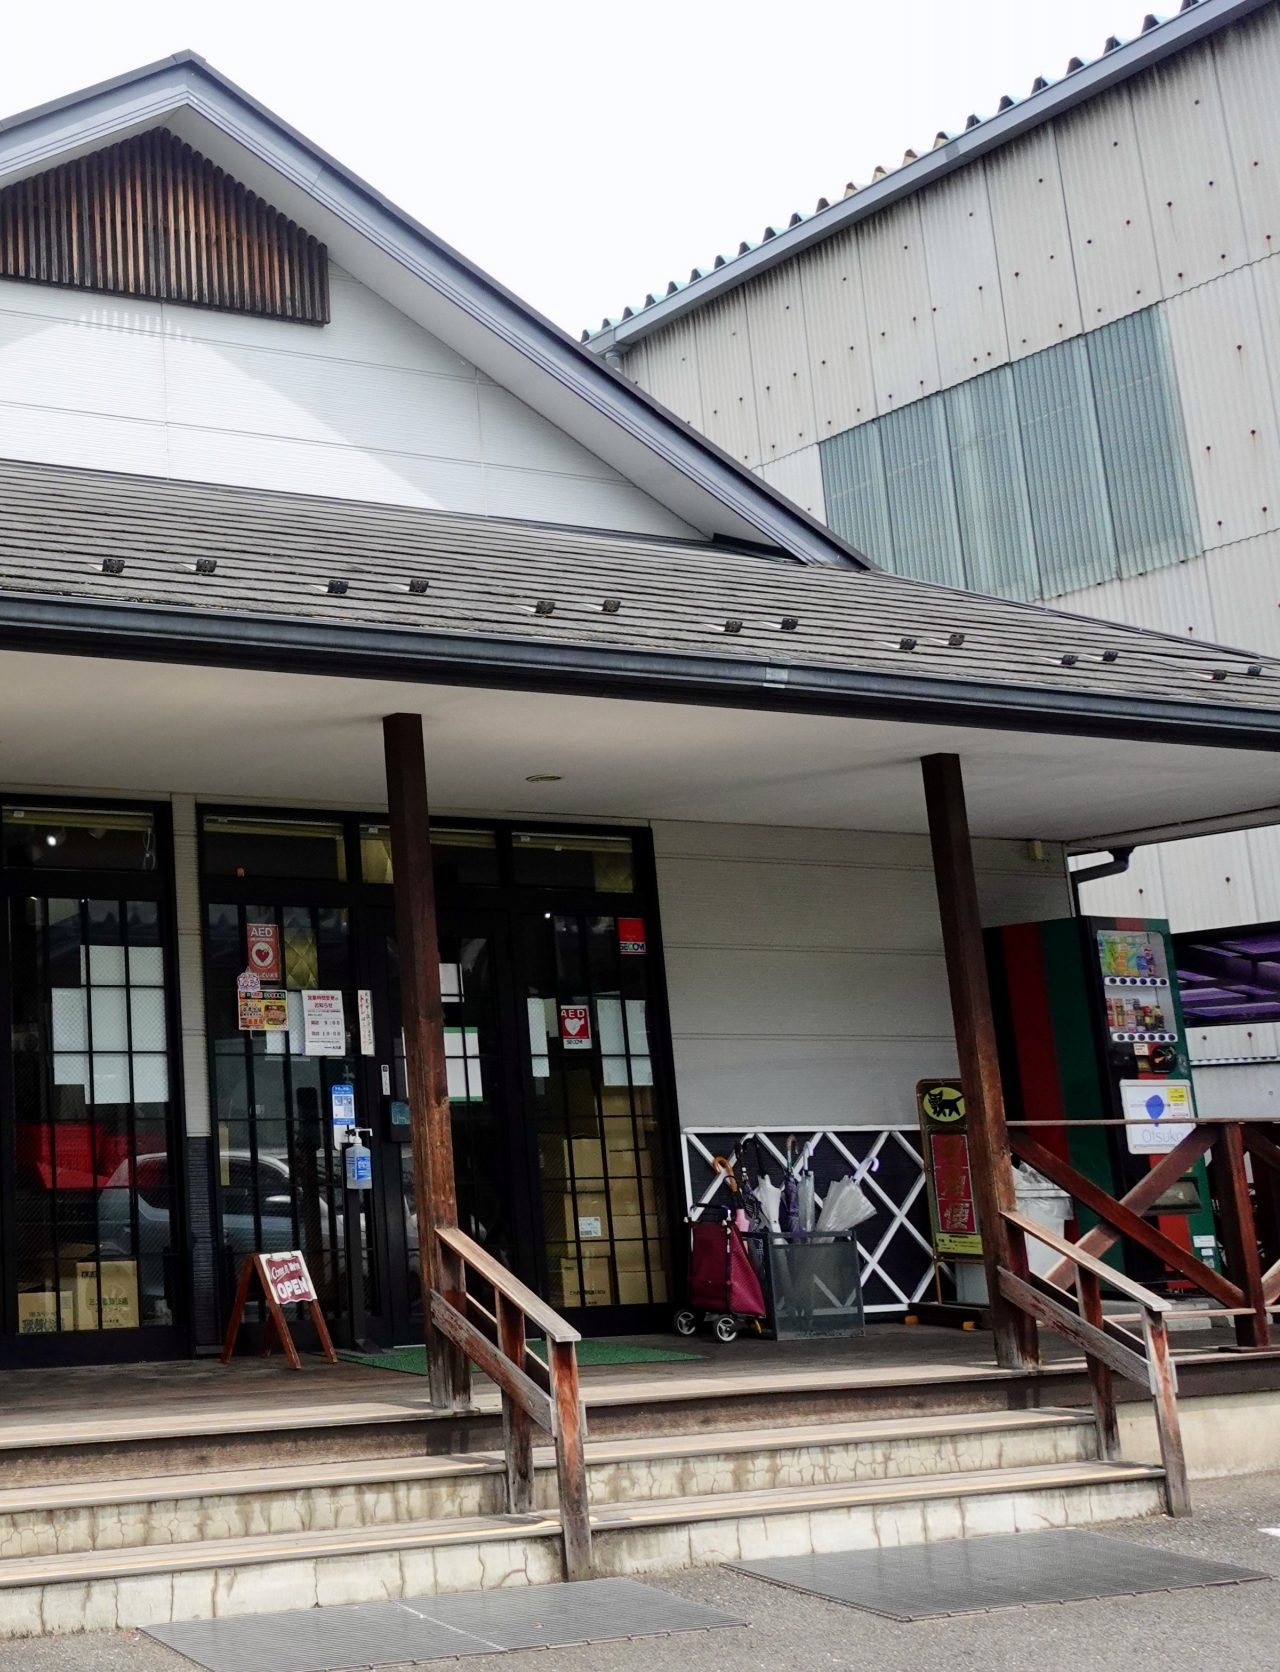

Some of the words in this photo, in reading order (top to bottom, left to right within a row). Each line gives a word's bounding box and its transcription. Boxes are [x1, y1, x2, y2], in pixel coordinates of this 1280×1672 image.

[250, 927, 273, 937] AED
[561, 1009, 585, 1018] AED
[277, 1277, 309, 1299] OPEN
